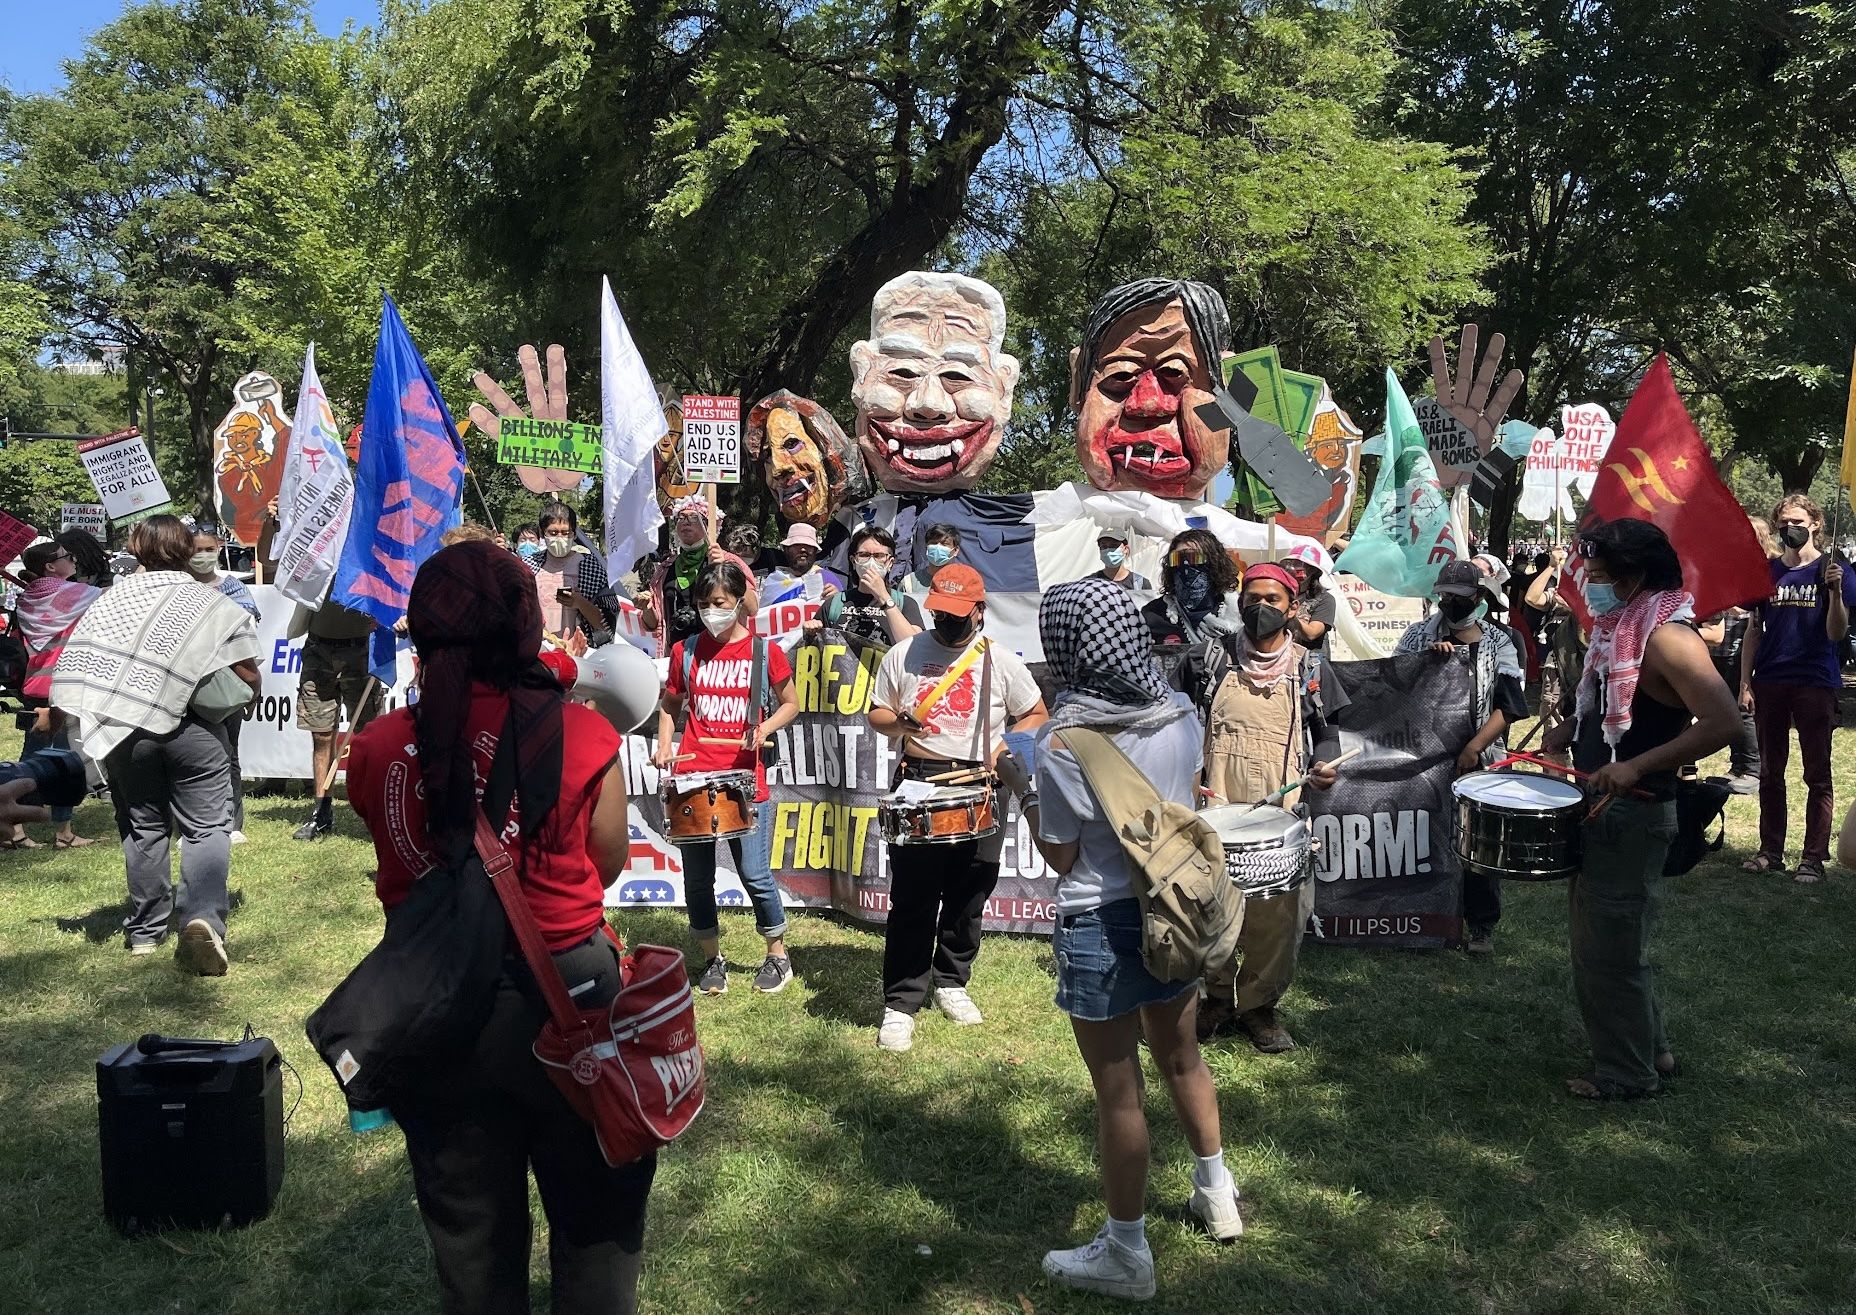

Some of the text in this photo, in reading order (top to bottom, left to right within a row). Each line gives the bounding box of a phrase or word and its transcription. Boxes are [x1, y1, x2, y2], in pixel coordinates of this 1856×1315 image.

[684, 398, 738, 409] STAND WITH
[684, 408, 738, 419] PALESTINE!
[1568, 411, 1603, 426] USA
[501, 419, 574, 440] BILLIONS
[687, 423, 736, 436] END U.S
[1419, 417, 1457, 436] RAELI
[1565, 427, 1607, 443] OUT
[687, 437, 737, 451] AID TO
[1428, 431, 1467, 451] MADE
[1532, 440, 1602, 459] OF THE
[86, 443, 142, 468] IMMIGRANT
[501, 446, 602, 471] MILITARY A
[688, 452, 736, 466] ISRAEL!
[1442, 446, 1480, 466] BOMBS
[92, 454, 147, 478] RIGHTS AND
[95, 463, 152, 485] LEGALIZATION
[100, 471, 158, 497] FOR ALL!
[77, 516, 104, 524] BORN
[78, 507, 103, 515] MUST
[1367, 601, 1386, 610] TO
[694, 694, 750, 724] UPRISIN
[770, 802, 878, 876] FIGHT
[1312, 809, 1432, 882] ORM!
[982, 899, 1005, 918] AL
[1012, 901, 1057, 920] LEAG
[1350, 917, 1421, 935] ILPS.US
